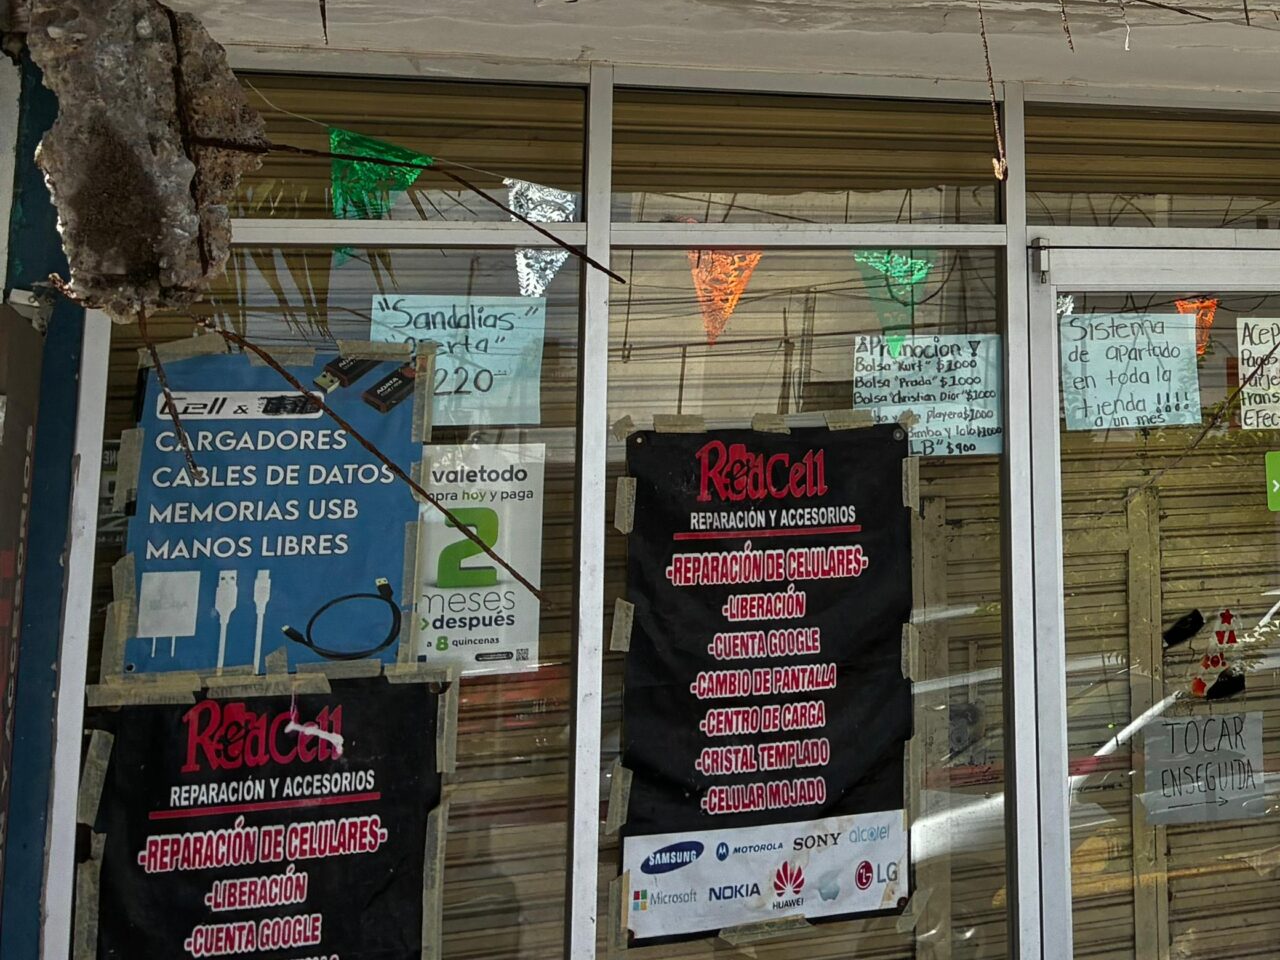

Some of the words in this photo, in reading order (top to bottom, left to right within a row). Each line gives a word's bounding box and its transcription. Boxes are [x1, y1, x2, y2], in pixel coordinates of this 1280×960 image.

[1070, 317, 1164, 341] Sistema
[1068, 345, 1090, 362] de
[1105, 341, 1181, 362] apartado
[855, 357, 891, 372] Bolsa
[854, 376, 890, 388] Bolsa
[1073, 375, 1096, 390] en
[1106, 367, 1150, 386] toda
[1157, 365, 1172, 382] la
[233, 405, 249, 415] &
[854, 392, 887, 404] Bolsa
[1114, 416, 1129, 427] un
[1137, 414, 1166, 425] mes
[155, 429, 347, 452] CARGADORES
[152, 466, 257, 488] CABLES
[266, 465, 299, 486] DE
[308, 464, 396, 485] DATOS
[432, 464, 527, 484] valetodo
[462, 489, 486, 506] hoy
[490, 492, 498, 502] y
[500, 489, 534, 505] paga
[149, 500, 299, 524] MEMORIAS
[308, 500, 359, 519] USB
[690, 506, 764, 530] REPARACIÓN
[768, 510, 777, 525] Y
[780, 506, 856, 527] ACCESORIOS
[145, 536, 252, 560] MANOS
[261, 534, 349, 556] LIBRES
[438, 507, 499, 588] 2
[765, 550, 785, 581] DE
[432, 610, 515, 631] después
[436, 636, 449, 652] 8
[452, 636, 500, 648] quincenas
[768, 628, 820, 656] GOOGLE
[752, 668, 772, 696] DE
[772, 663, 837, 693] PANTALLA
[761, 705, 781, 733] DE
[782, 700, 826, 730] CARGA
[1162, 716, 1246, 754] TOCAR
[758, 738, 830, 771] TEMPLADO
[170, 775, 265, 808] REPARACIÓN
[270, 778, 279, 798] Y
[282, 770, 376, 796] ACCESORIOS
[1161, 759, 1256, 798] ENSEGUIDA
[766, 776, 826, 810] MOJADO
[260, 826, 285, 862] DE
[649, 846, 697, 866] SAMSUNG
[732, 842, 784, 854] MOTOROLA
[793, 832, 842, 851] SONY
[650, 890, 697, 906] Microsoft
[708, 883, 761, 902] NOKIA
[772, 898, 804, 910] HUAWEI
[876, 862, 898, 884] LG
[258, 914, 322, 950] GOOGLE
